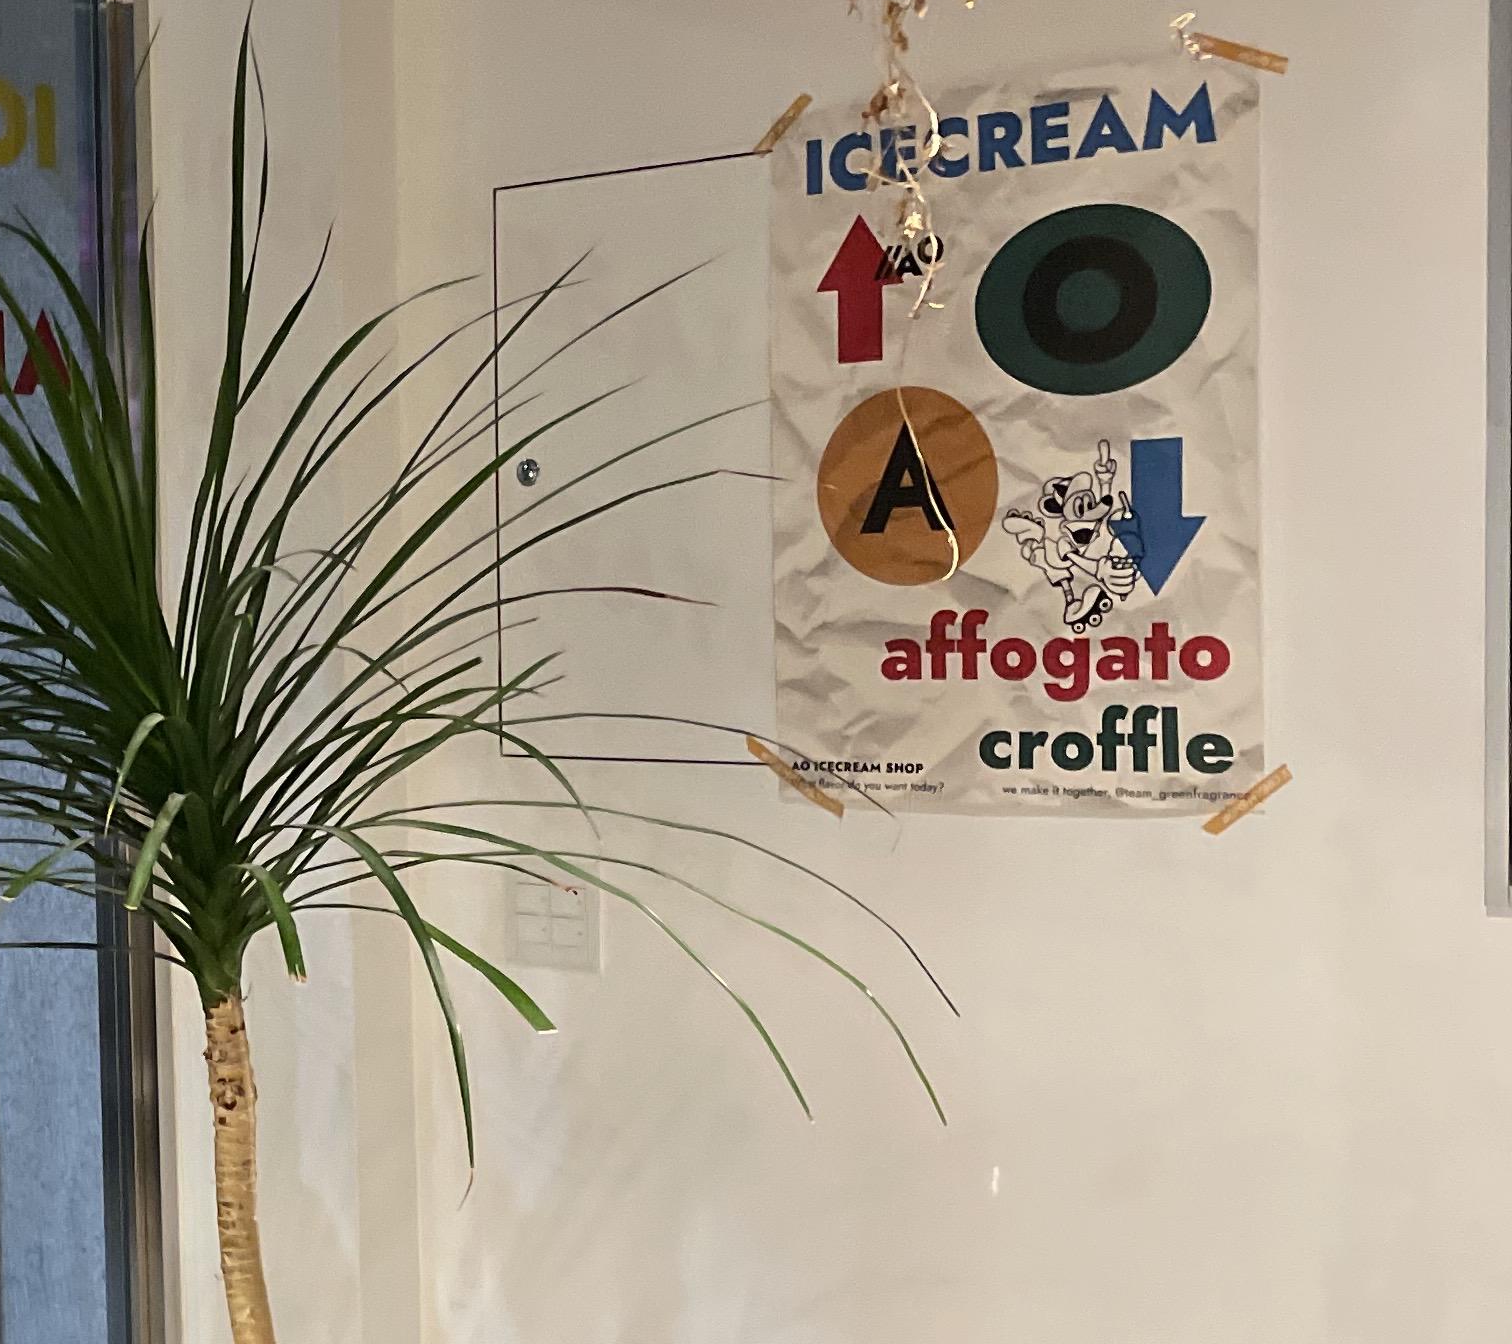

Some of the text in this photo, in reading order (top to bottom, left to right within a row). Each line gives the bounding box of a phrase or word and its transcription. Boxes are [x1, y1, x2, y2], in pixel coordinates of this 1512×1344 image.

[806, 80, 1217, 196] ICECREAM
[861, 422, 955, 534] A
[880, 608, 1231, 702] affogato
[792, 761, 924, 774] AO ICECREAM SHOP
[979, 704, 1234, 774] croffle
[864, 782, 882, 791] you
[885, 783, 907, 791] want
[911, 782, 944, 794] today?
[1002, 785, 1017, 794] we
[1021, 785, 1049, 796] make
[1052, 785, 1060, 796] it
